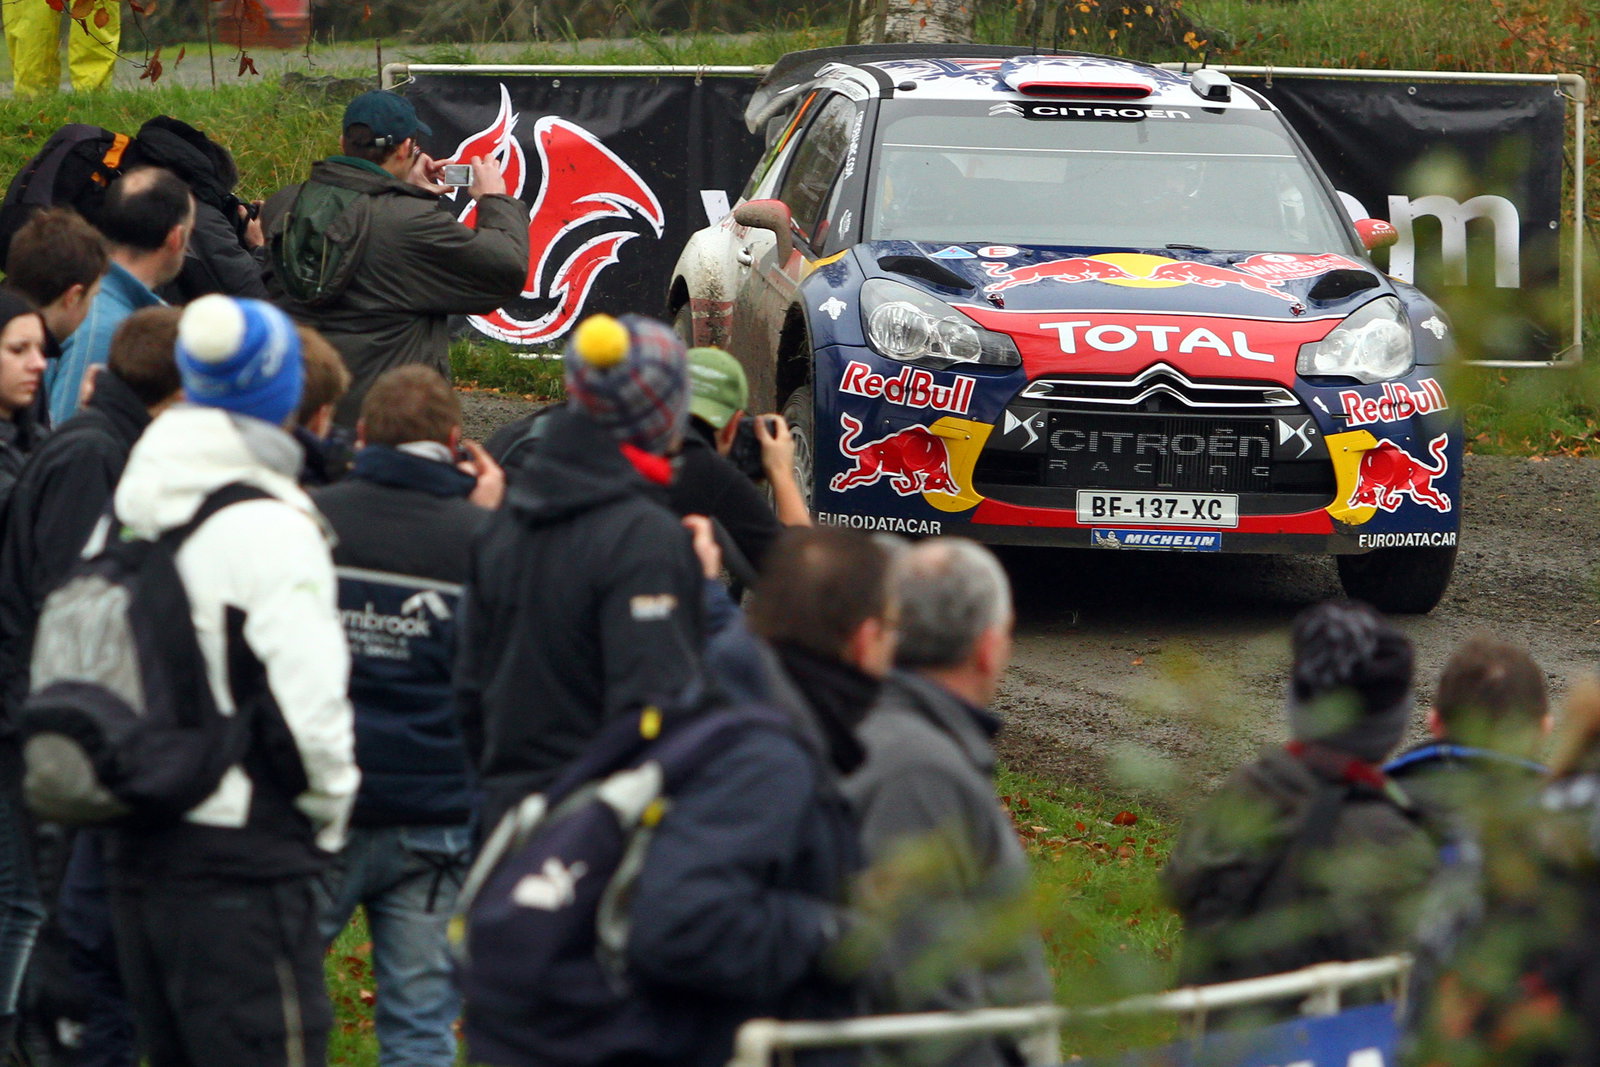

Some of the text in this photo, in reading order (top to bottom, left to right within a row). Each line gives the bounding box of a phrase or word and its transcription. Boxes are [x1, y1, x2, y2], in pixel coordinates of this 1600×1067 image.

[1039, 320, 1275, 363] TOTAL
[1092, 496, 1222, 521] BF-137-XC
[818, 511, 942, 535] EURODATACAR
[1124, 533, 1216, 547] MICHELIN
[1359, 532, 1457, 548] EURODATACAR
